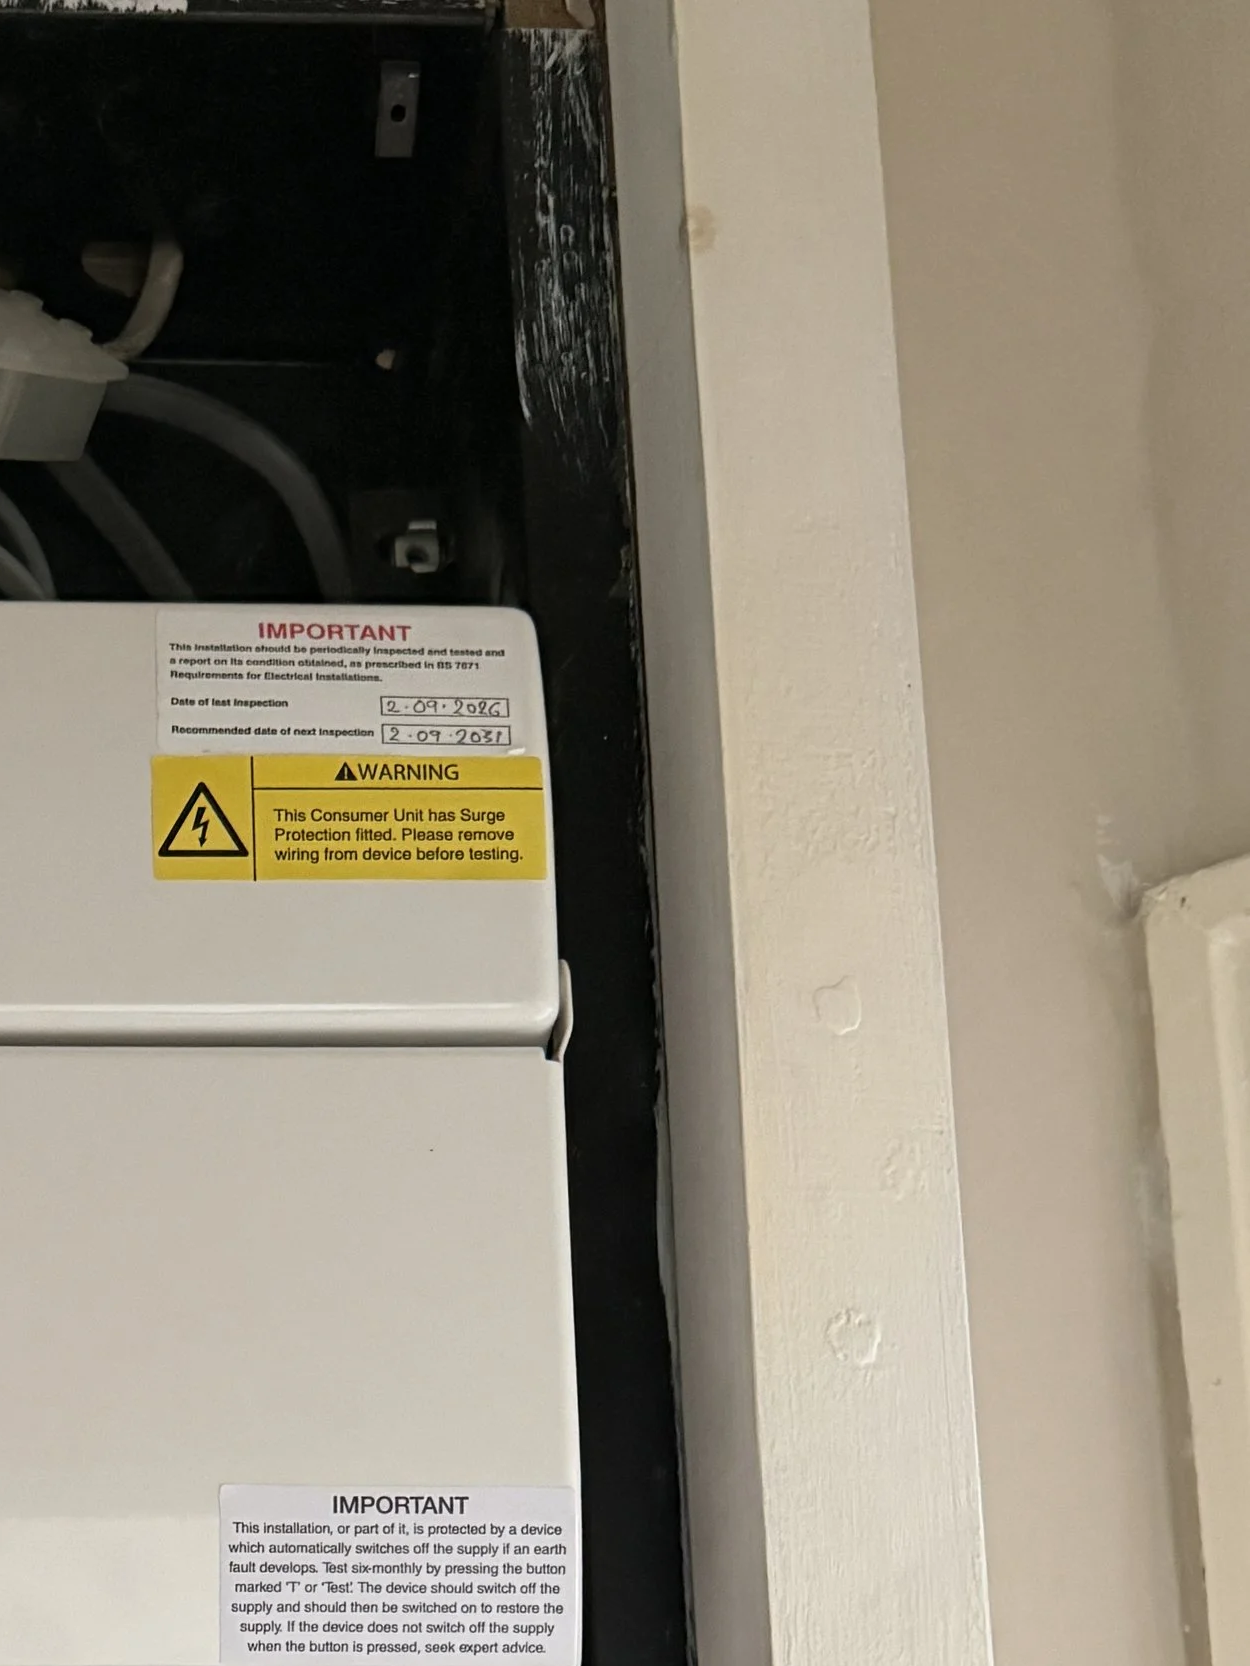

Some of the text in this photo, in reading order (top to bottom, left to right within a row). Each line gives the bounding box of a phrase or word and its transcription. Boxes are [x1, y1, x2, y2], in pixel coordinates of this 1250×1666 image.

[259, 623, 412, 641] IMPORTANT
[171, 697, 289, 708] Date of last inspection
[172, 726, 374, 738] Recommended date of next inspection
[358, 764, 459, 780] WARNING
[273, 808, 505, 824] This Consumer Unit has Surge
[275, 828, 514, 841] Protection fitted. Please remove
[274, 847, 523, 864] wiring from device before testing.
[333, 1496, 469, 1514] IMPORTANT
[232, 1522, 562, 1538] This installation, or part of it, is protected by a device
[228, 1542, 567, 1557] which automatically switches off the supply if an earth
[229, 1561, 566, 1577] fault develops. Test six-monthly by pressing the button
